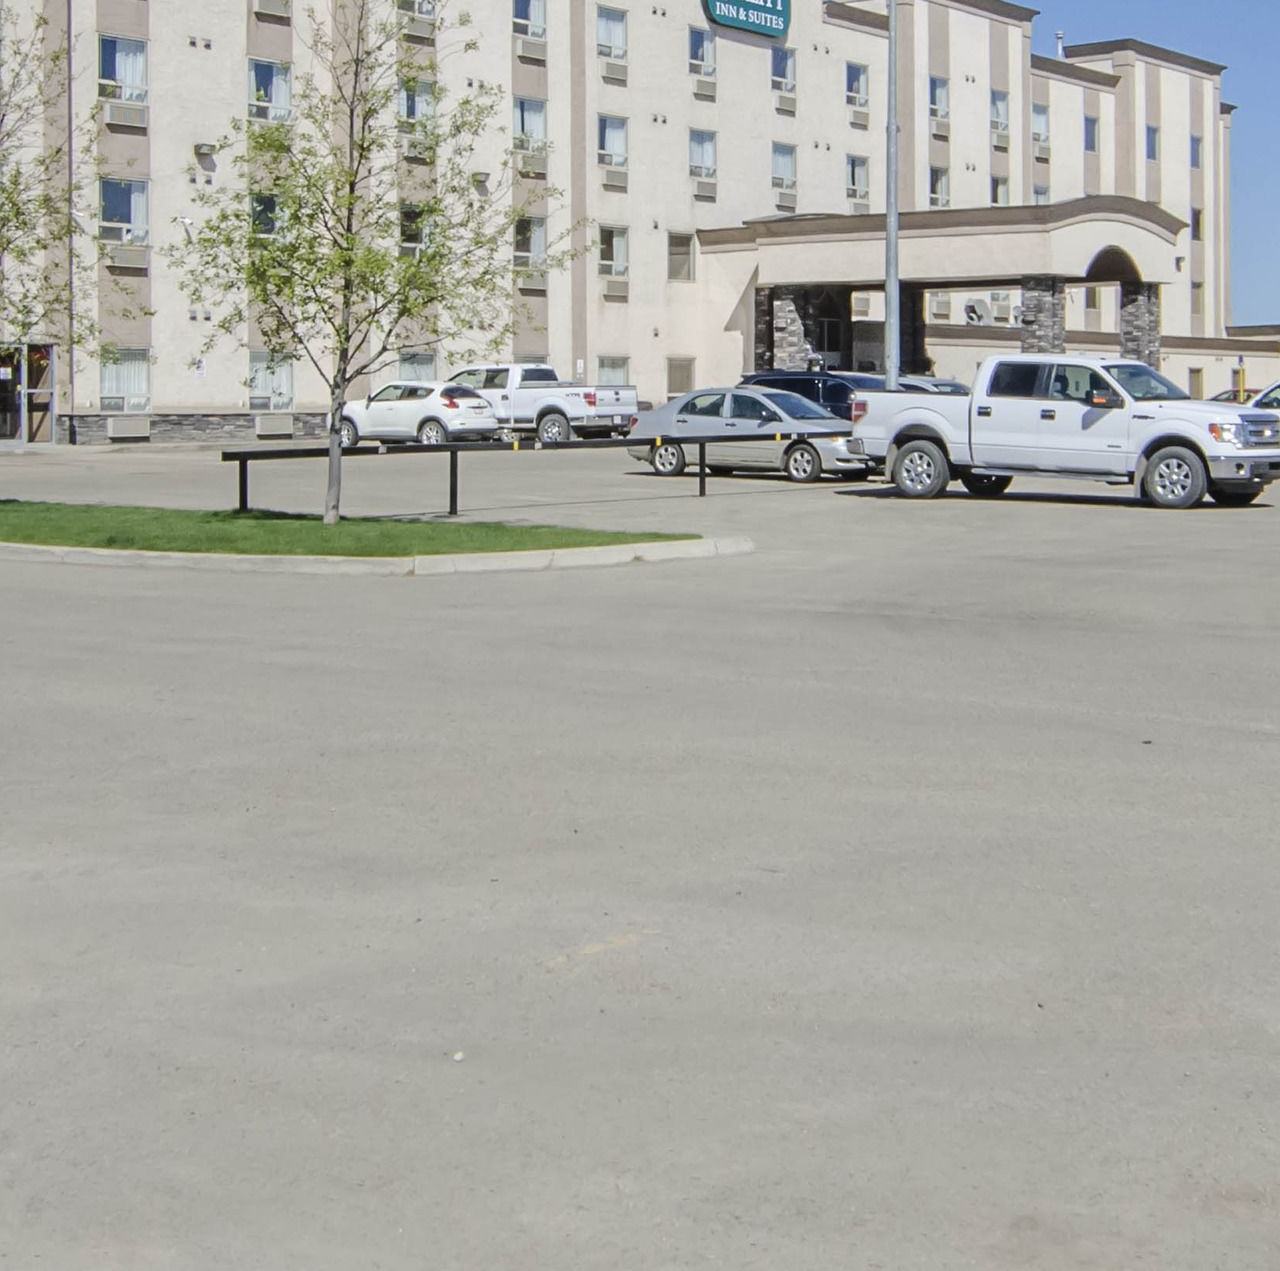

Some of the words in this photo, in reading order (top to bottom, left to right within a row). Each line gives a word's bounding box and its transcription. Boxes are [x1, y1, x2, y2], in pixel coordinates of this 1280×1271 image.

[715, 1, 737, 18] INN
[738, 7, 747, 21] &
[748, 9, 784, 29] SUITES
